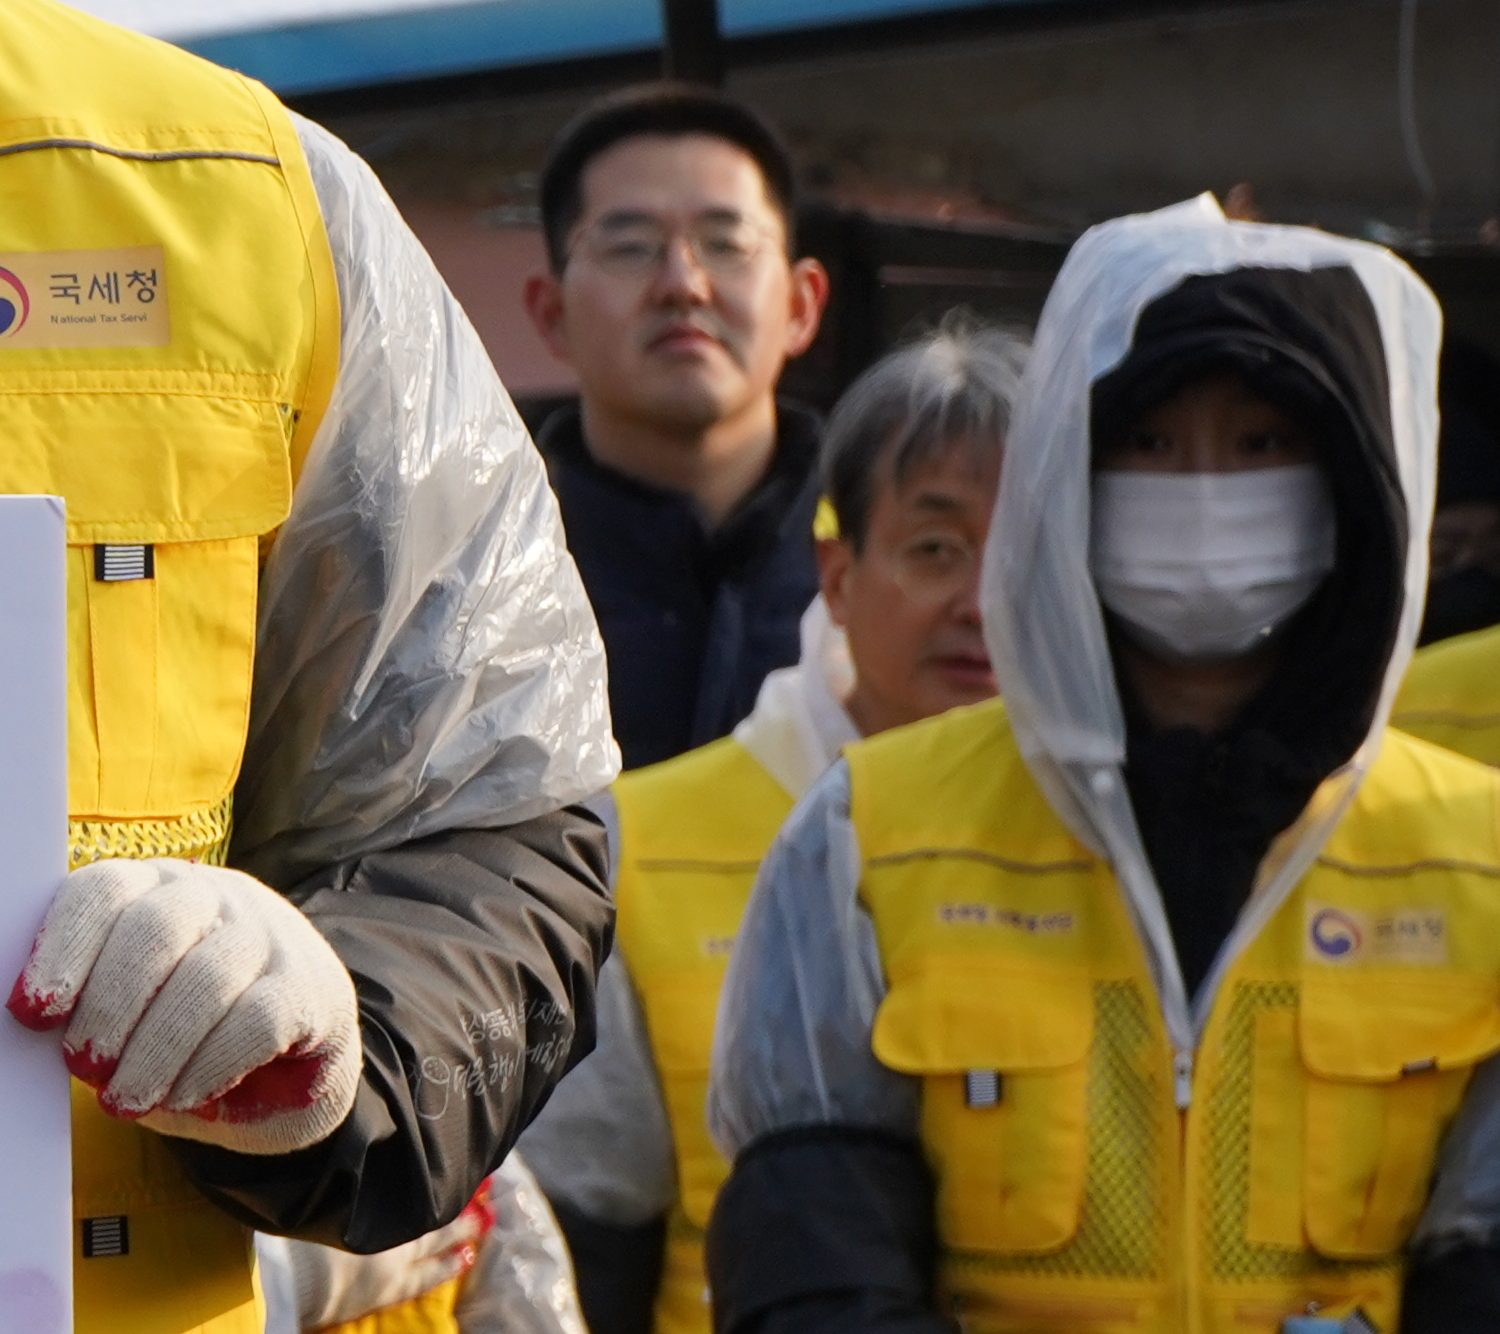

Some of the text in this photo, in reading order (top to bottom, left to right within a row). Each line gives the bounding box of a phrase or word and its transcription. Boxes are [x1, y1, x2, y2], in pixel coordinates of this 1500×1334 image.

[49, 268, 158, 305] 국세청
[50, 313, 97, 324] National
[100, 313, 118, 323] Tax
